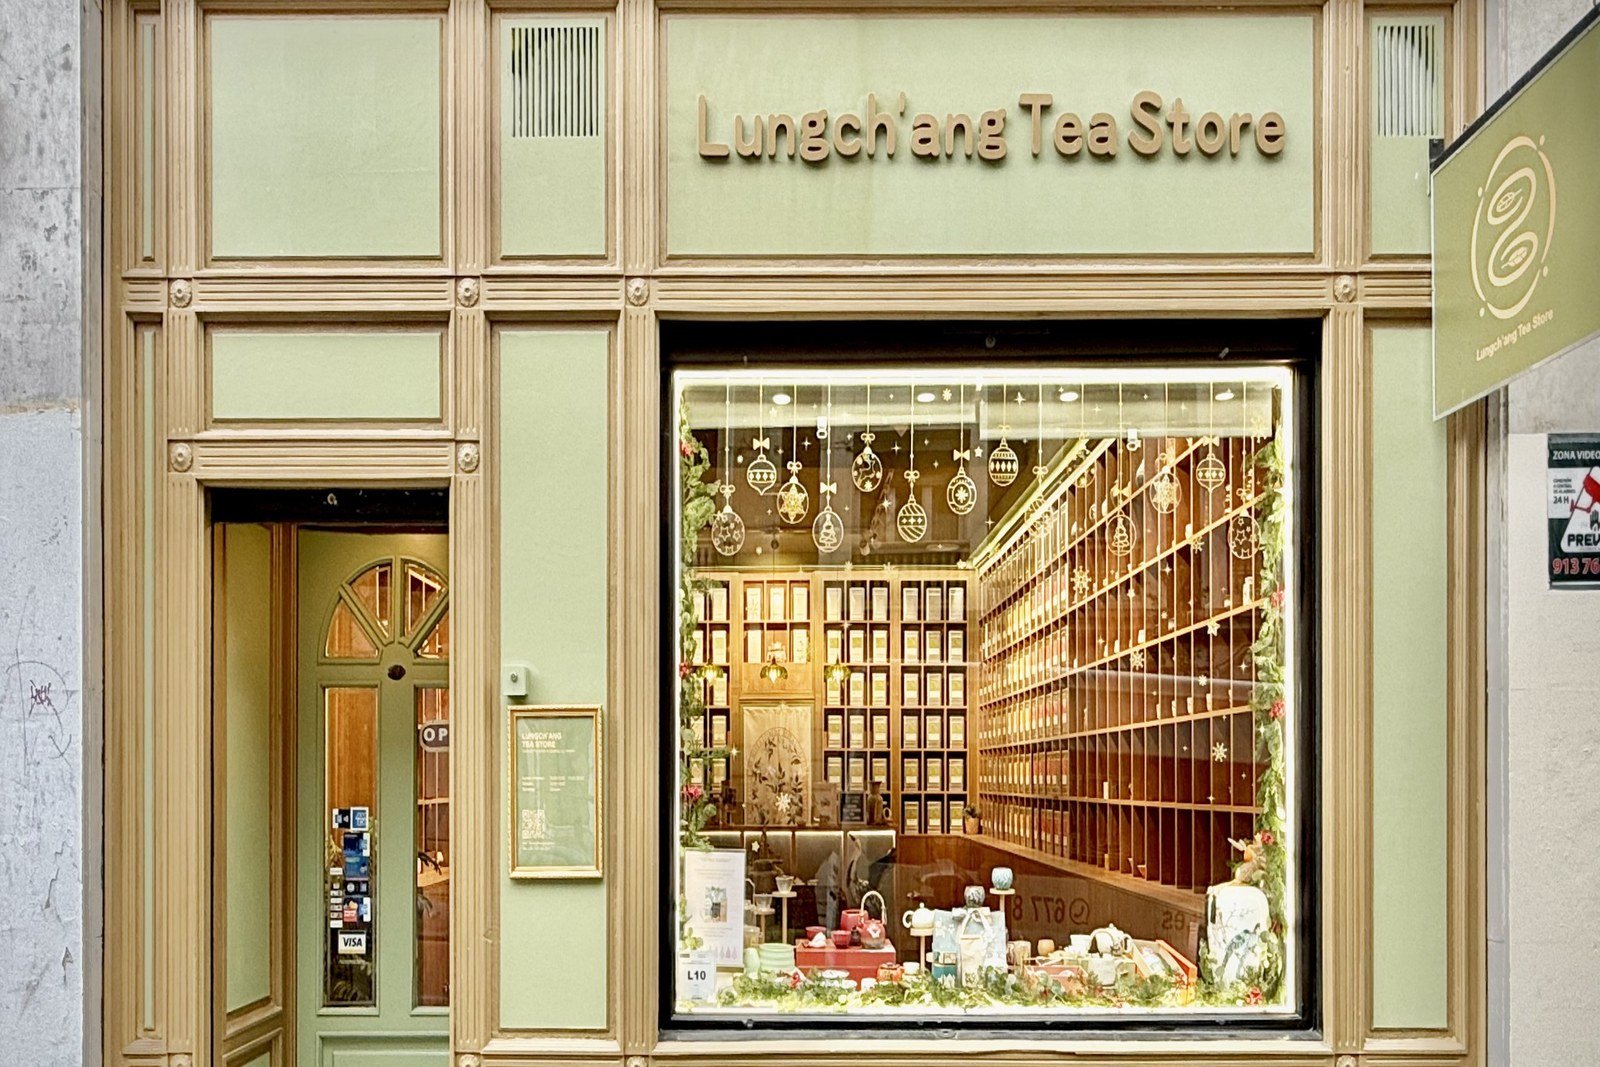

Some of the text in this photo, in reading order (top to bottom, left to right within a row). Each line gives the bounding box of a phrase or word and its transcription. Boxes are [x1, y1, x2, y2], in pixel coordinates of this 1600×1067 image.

[697, 90, 1287, 162] Lungch'ang Tea Store
[1476, 309, 1553, 361] Lungch'ang Tea Store
[1552, 450, 1576, 460] ZONA
[1553, 496, 1569, 504] 24 H
[1552, 557, 1580, 575] 913
[343, 937, 362, 947] VISA
[687, 970, 706, 981] L10
